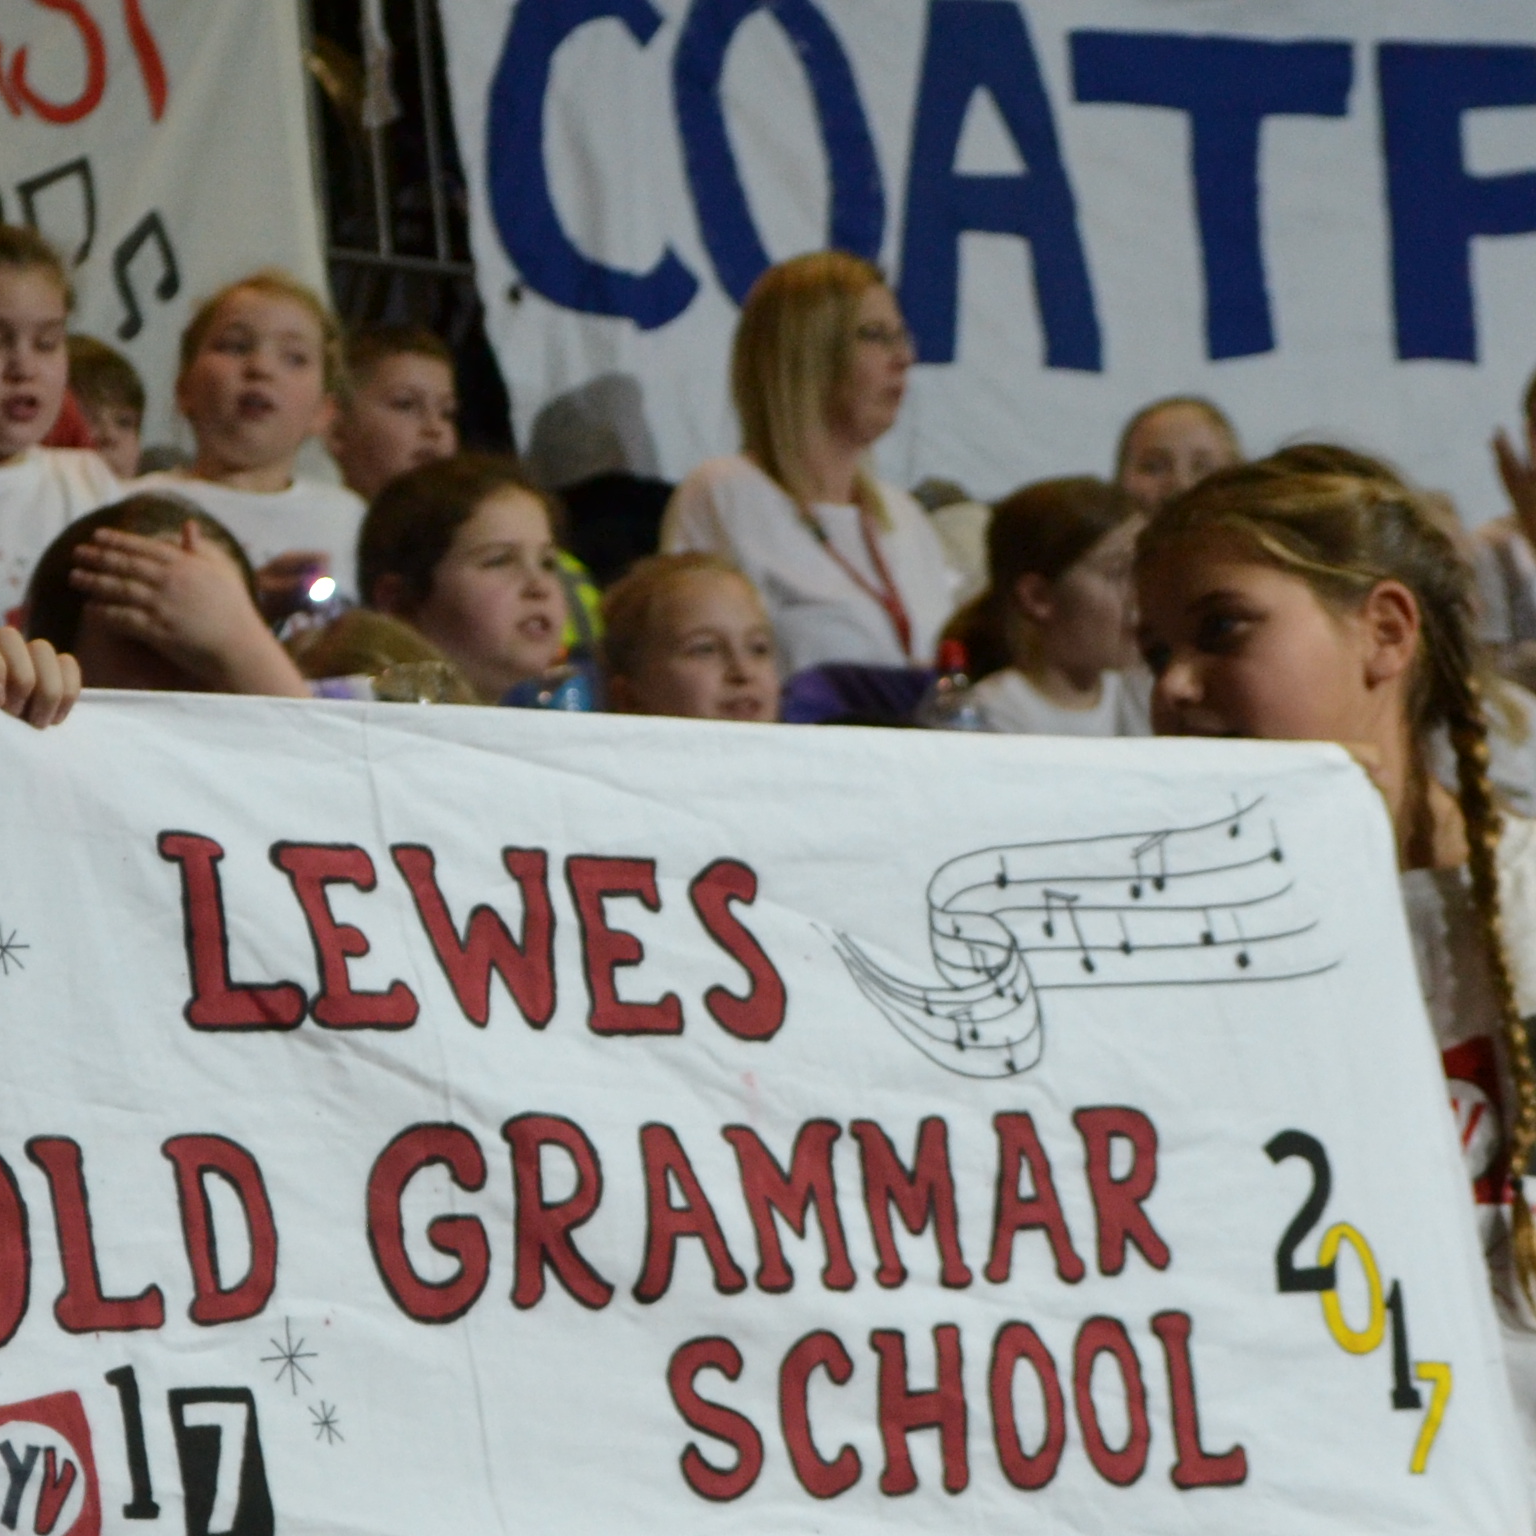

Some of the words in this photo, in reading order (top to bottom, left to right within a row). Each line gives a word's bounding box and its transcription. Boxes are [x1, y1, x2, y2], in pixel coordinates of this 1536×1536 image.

[158, 830, 788, 1041] LEWES
[366, 1105, 1171, 1325] GRAMMAR
[666, 1312, 1249, 1501] SCHOOL
